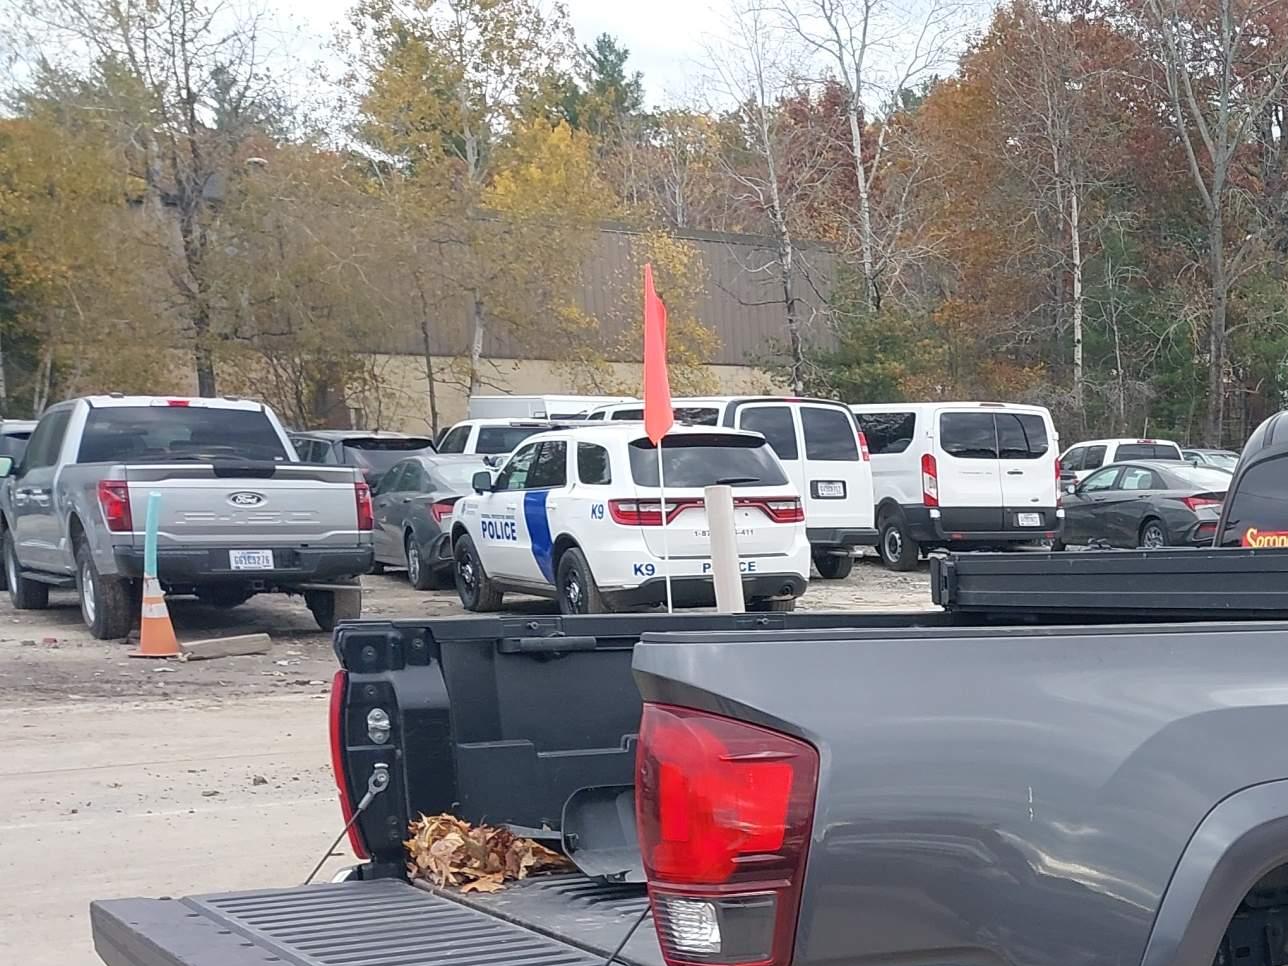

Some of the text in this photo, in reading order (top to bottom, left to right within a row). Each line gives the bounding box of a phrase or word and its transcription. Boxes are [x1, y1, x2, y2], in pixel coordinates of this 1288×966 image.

[590, 504, 605, 519] K9
[481, 520, 517, 541] POLICE
[634, 563, 656, 576] K9
